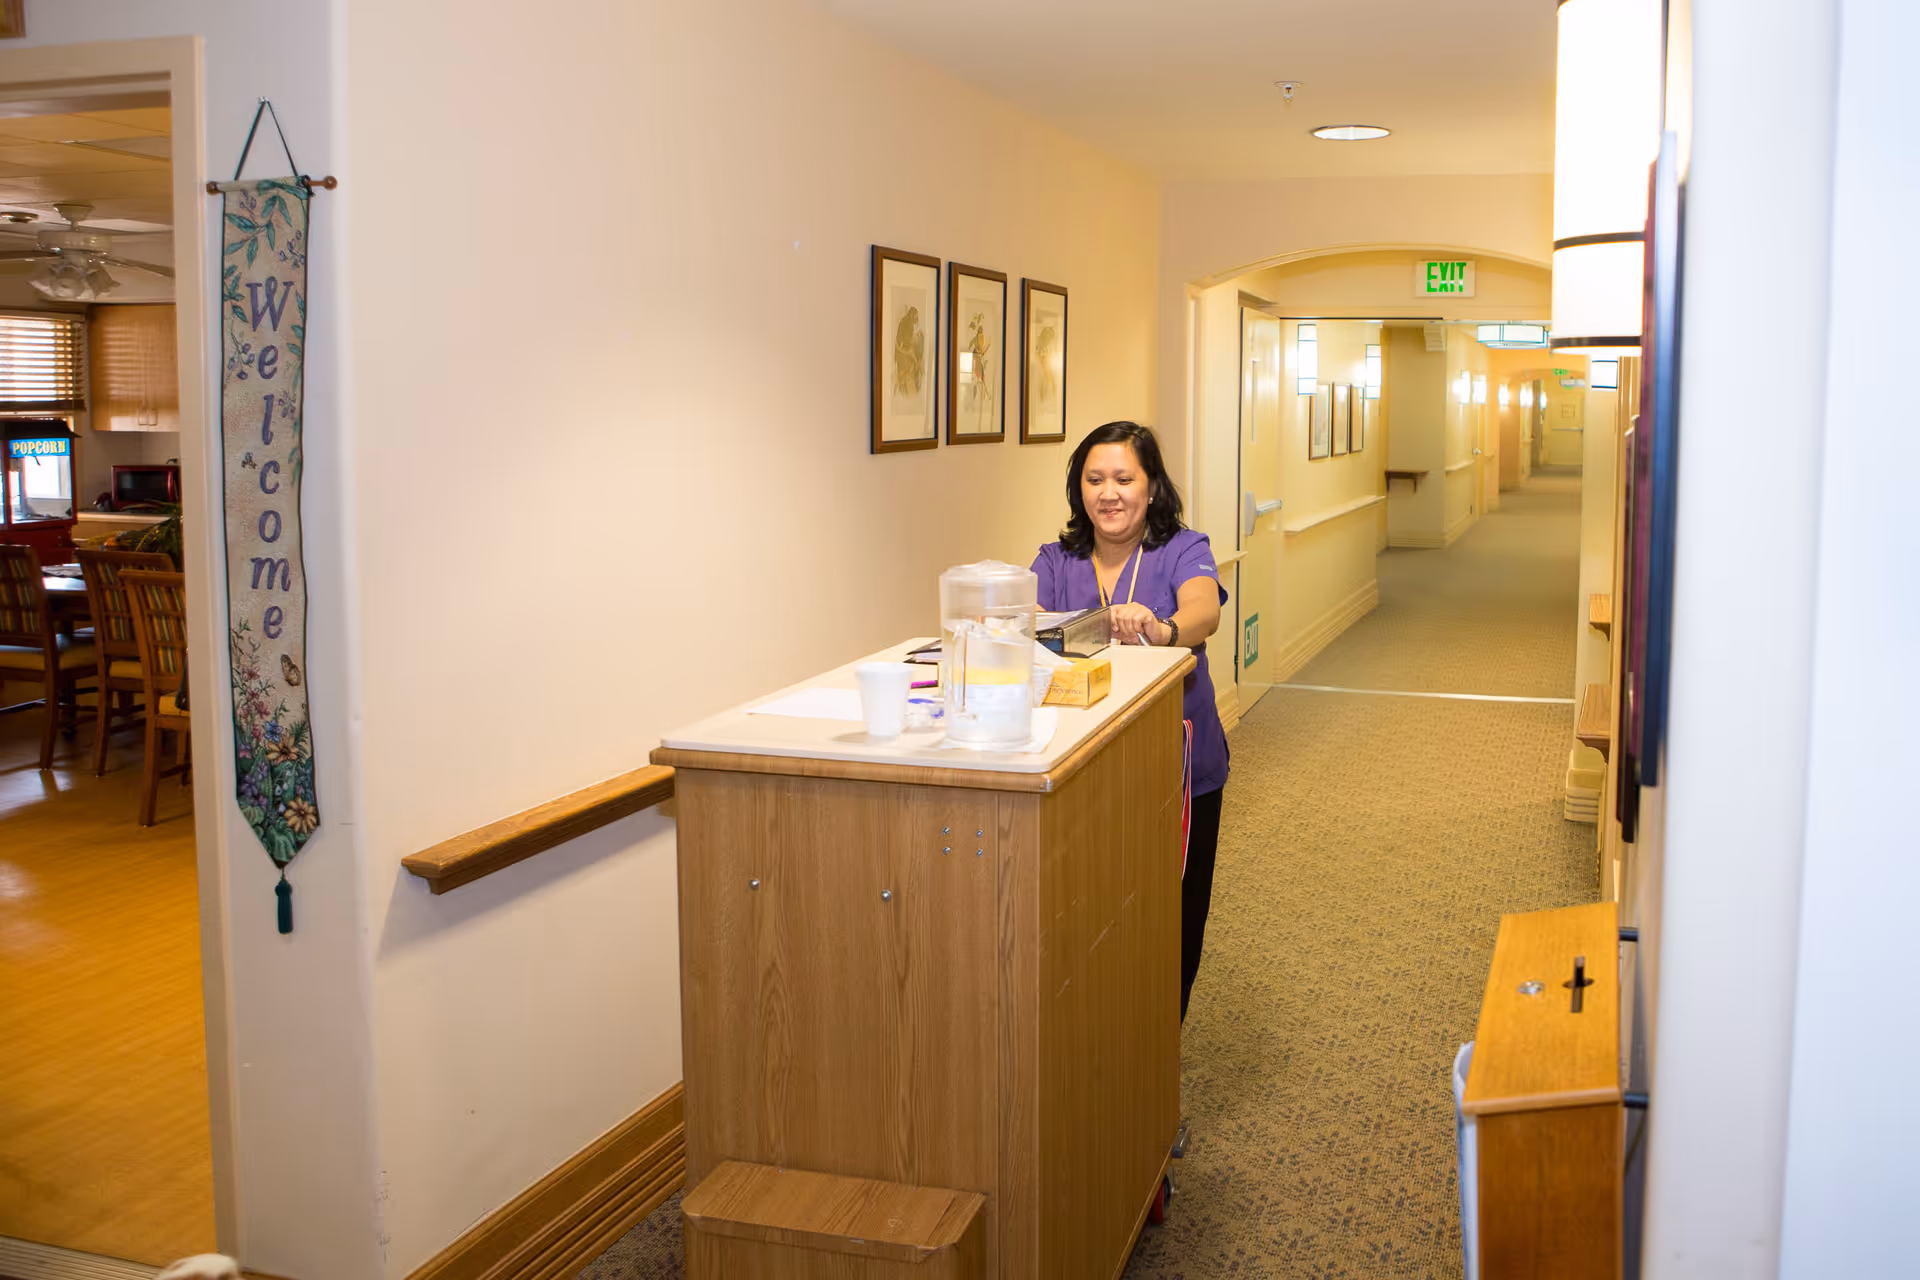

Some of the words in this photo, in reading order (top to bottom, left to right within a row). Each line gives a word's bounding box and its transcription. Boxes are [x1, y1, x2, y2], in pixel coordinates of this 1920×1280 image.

[1426, 262, 1467, 292] EXIT
[12, 440, 66, 455] POPCORN
[246, 276, 295, 640] Welcome
